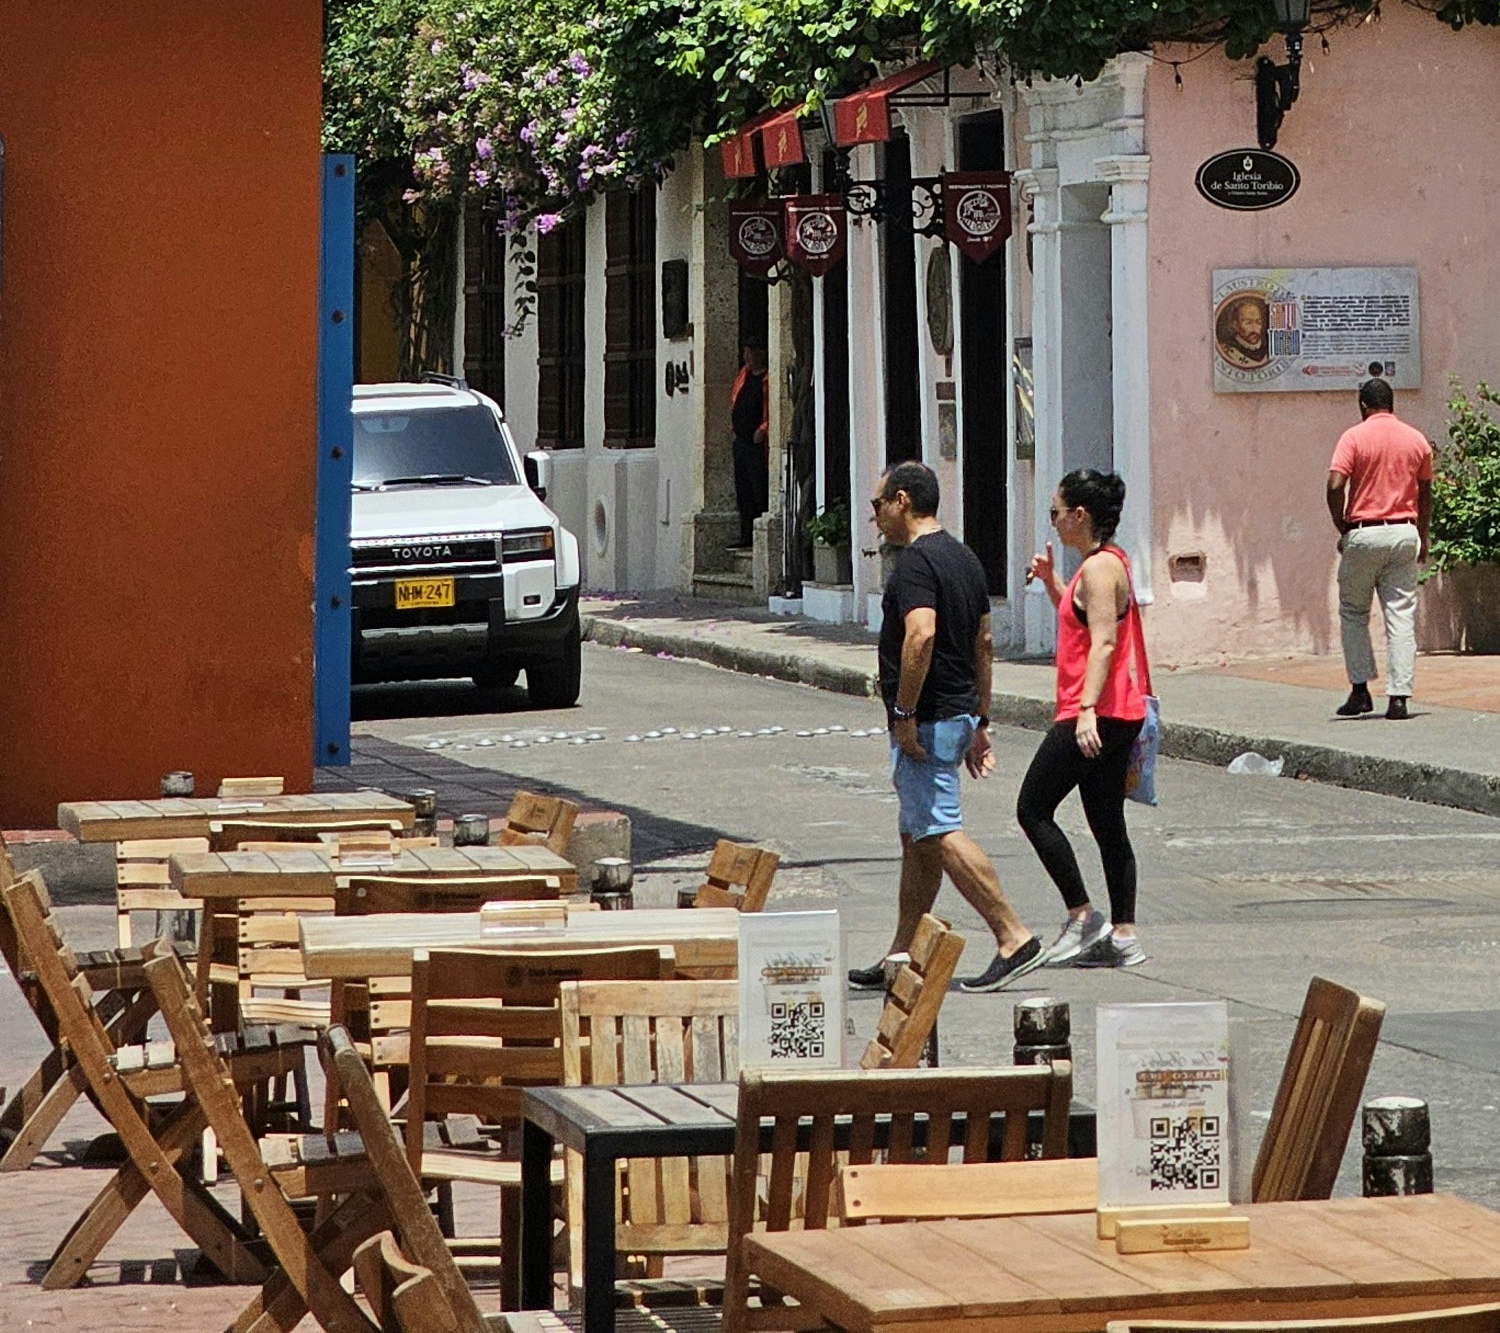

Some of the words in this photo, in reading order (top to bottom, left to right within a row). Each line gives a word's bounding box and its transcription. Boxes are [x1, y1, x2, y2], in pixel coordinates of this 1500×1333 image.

[1232, 171, 1262, 182] Iglesia
[1210, 181, 1222, 190] de
[1224, 181, 1250, 190] Santo
[1250, 181, 1284, 190] Toribio
[391, 545, 452, 559] TOYOTA
